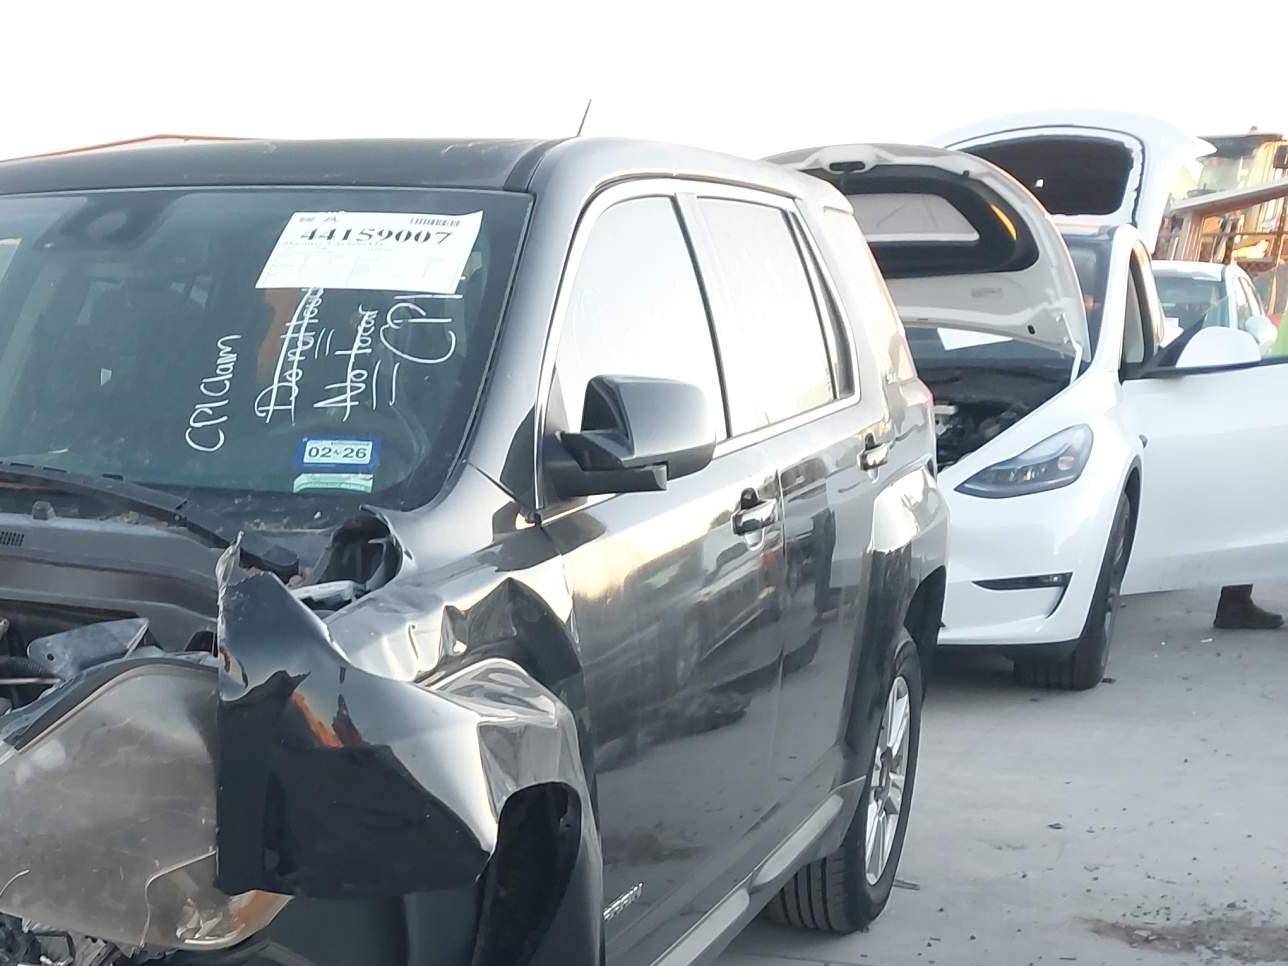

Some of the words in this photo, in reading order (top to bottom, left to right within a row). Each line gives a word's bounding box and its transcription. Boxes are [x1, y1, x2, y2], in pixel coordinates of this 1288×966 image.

[300, 228, 453, 245] 44159007
[313, 368, 368, 408] No
[185, 399, 229, 452] CPI
